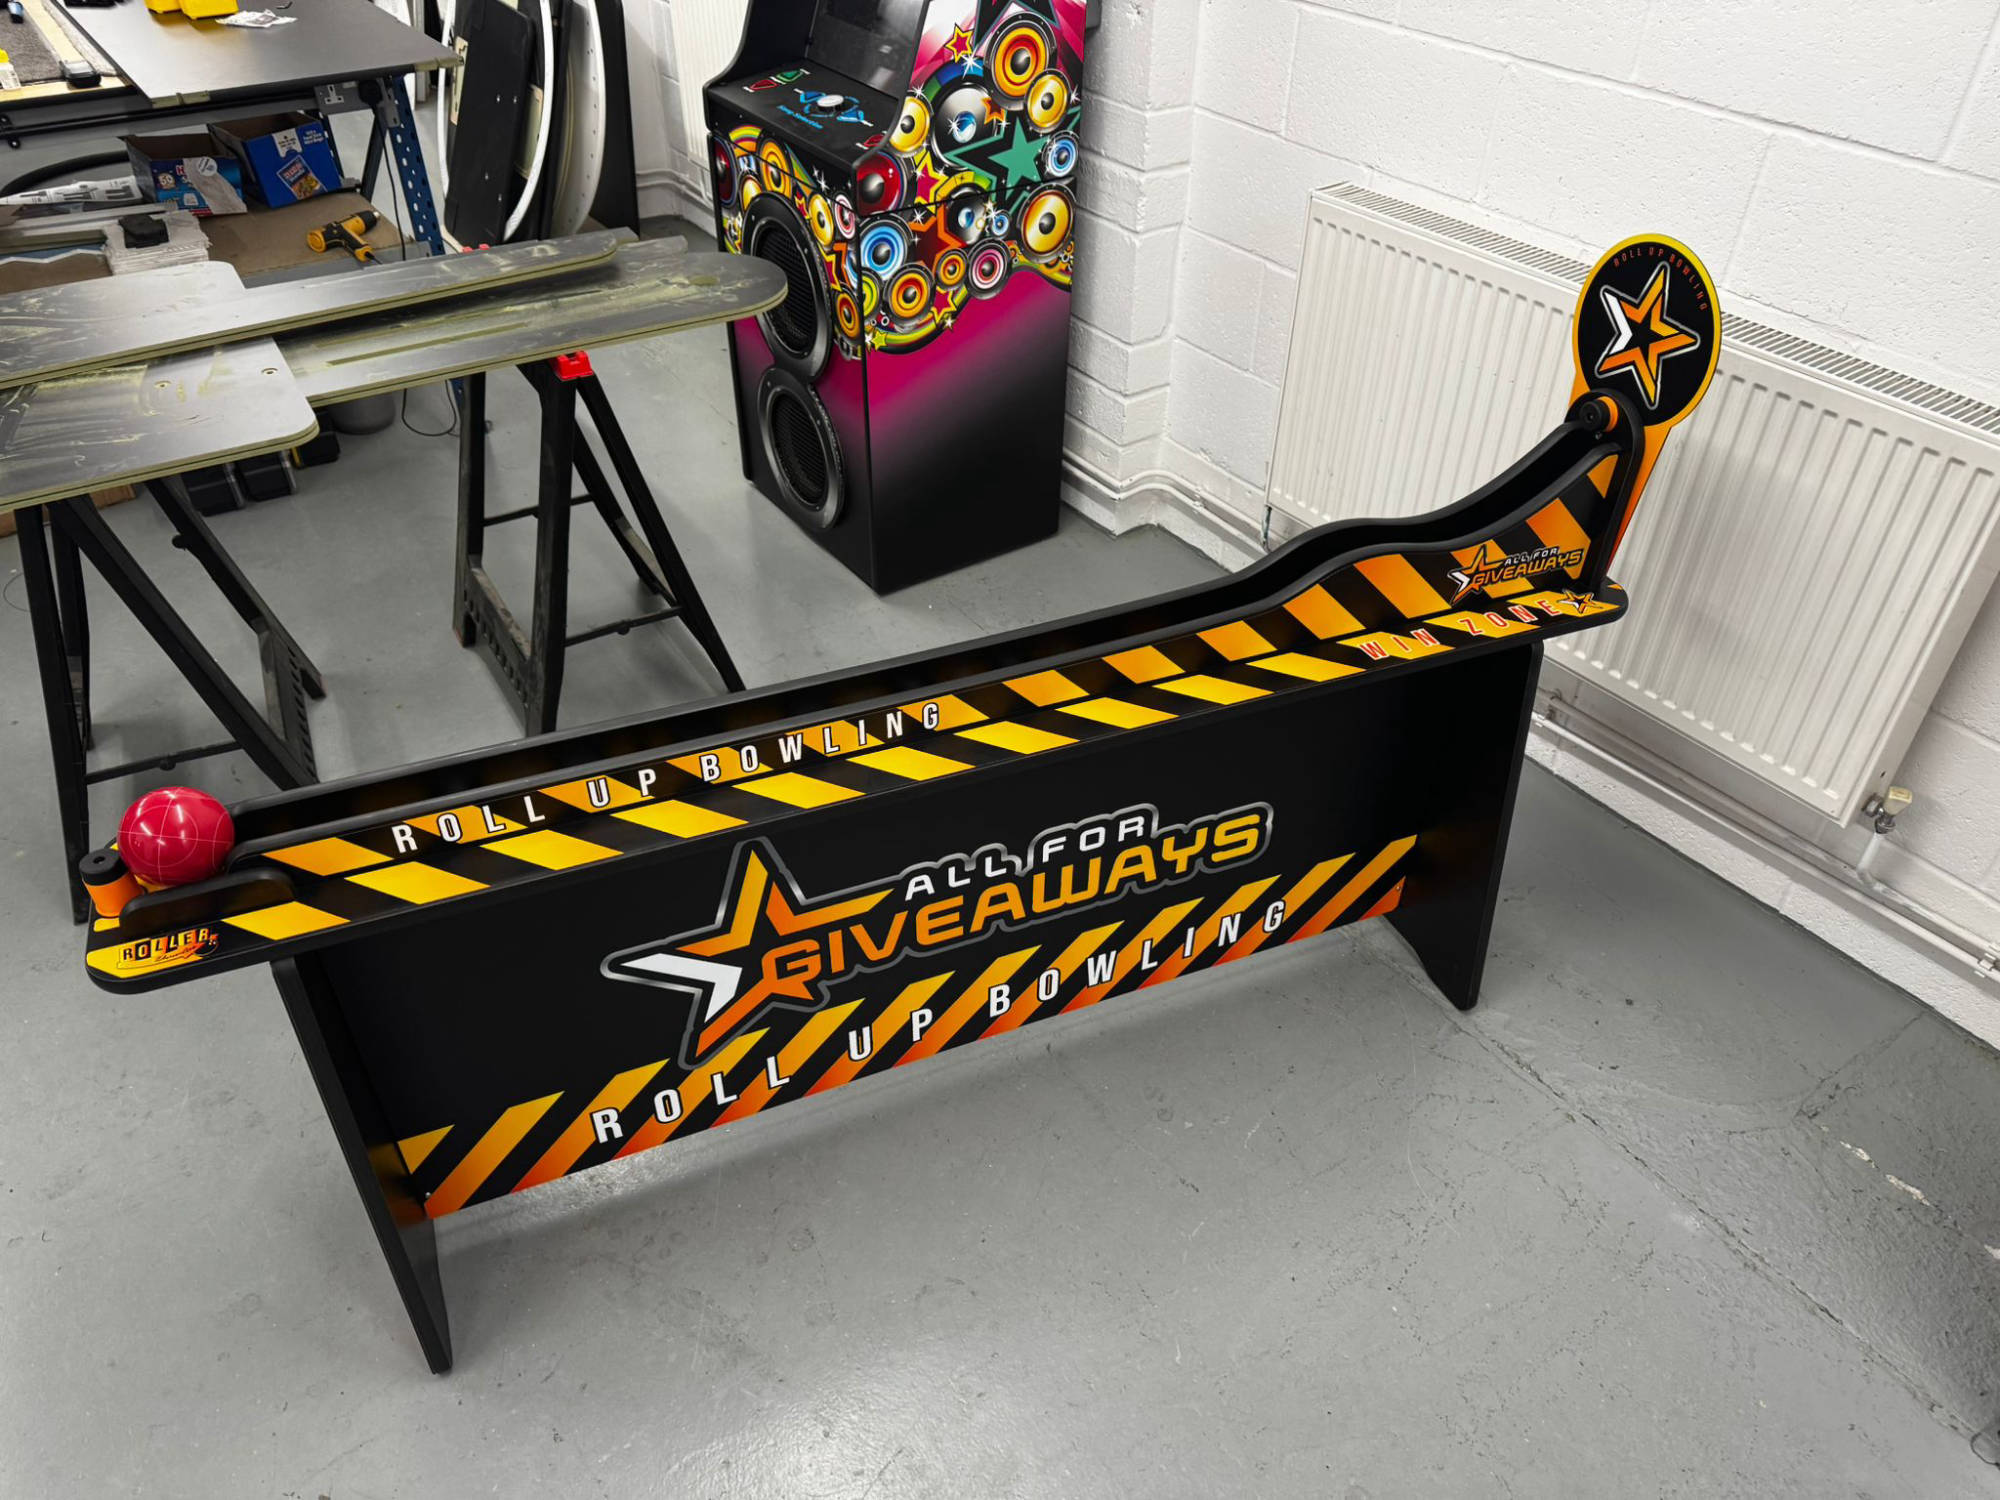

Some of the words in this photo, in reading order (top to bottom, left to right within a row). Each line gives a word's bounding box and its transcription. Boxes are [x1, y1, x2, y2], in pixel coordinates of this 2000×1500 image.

[1613, 247, 1642, 268] ROLL
[1648, 247, 1664, 257] UP
[1669, 254, 1708, 311] BOWLING
[1472, 550, 1583, 586] GIVEAWAYS
[1504, 553, 1530, 565] ALL
[1533, 548, 1559, 559] FOR
[1360, 628, 1440, 660] WIN
[1459, 600, 1562, 636] ZONE
[392, 795, 546, 854] ROLL
[587, 769, 657, 809] UP
[699, 702, 940, 783] BOWLING
[904, 857, 1008, 901] ALL
[1041, 815, 1146, 862] FOR
[761, 813, 1261, 985] GIVEAWAYS
[122, 928, 210, 961] ROLLER
[590, 1055, 790, 1144] ROLL
[848, 1008, 933, 1062] UP
[987, 898, 1285, 1019] BOWLING
